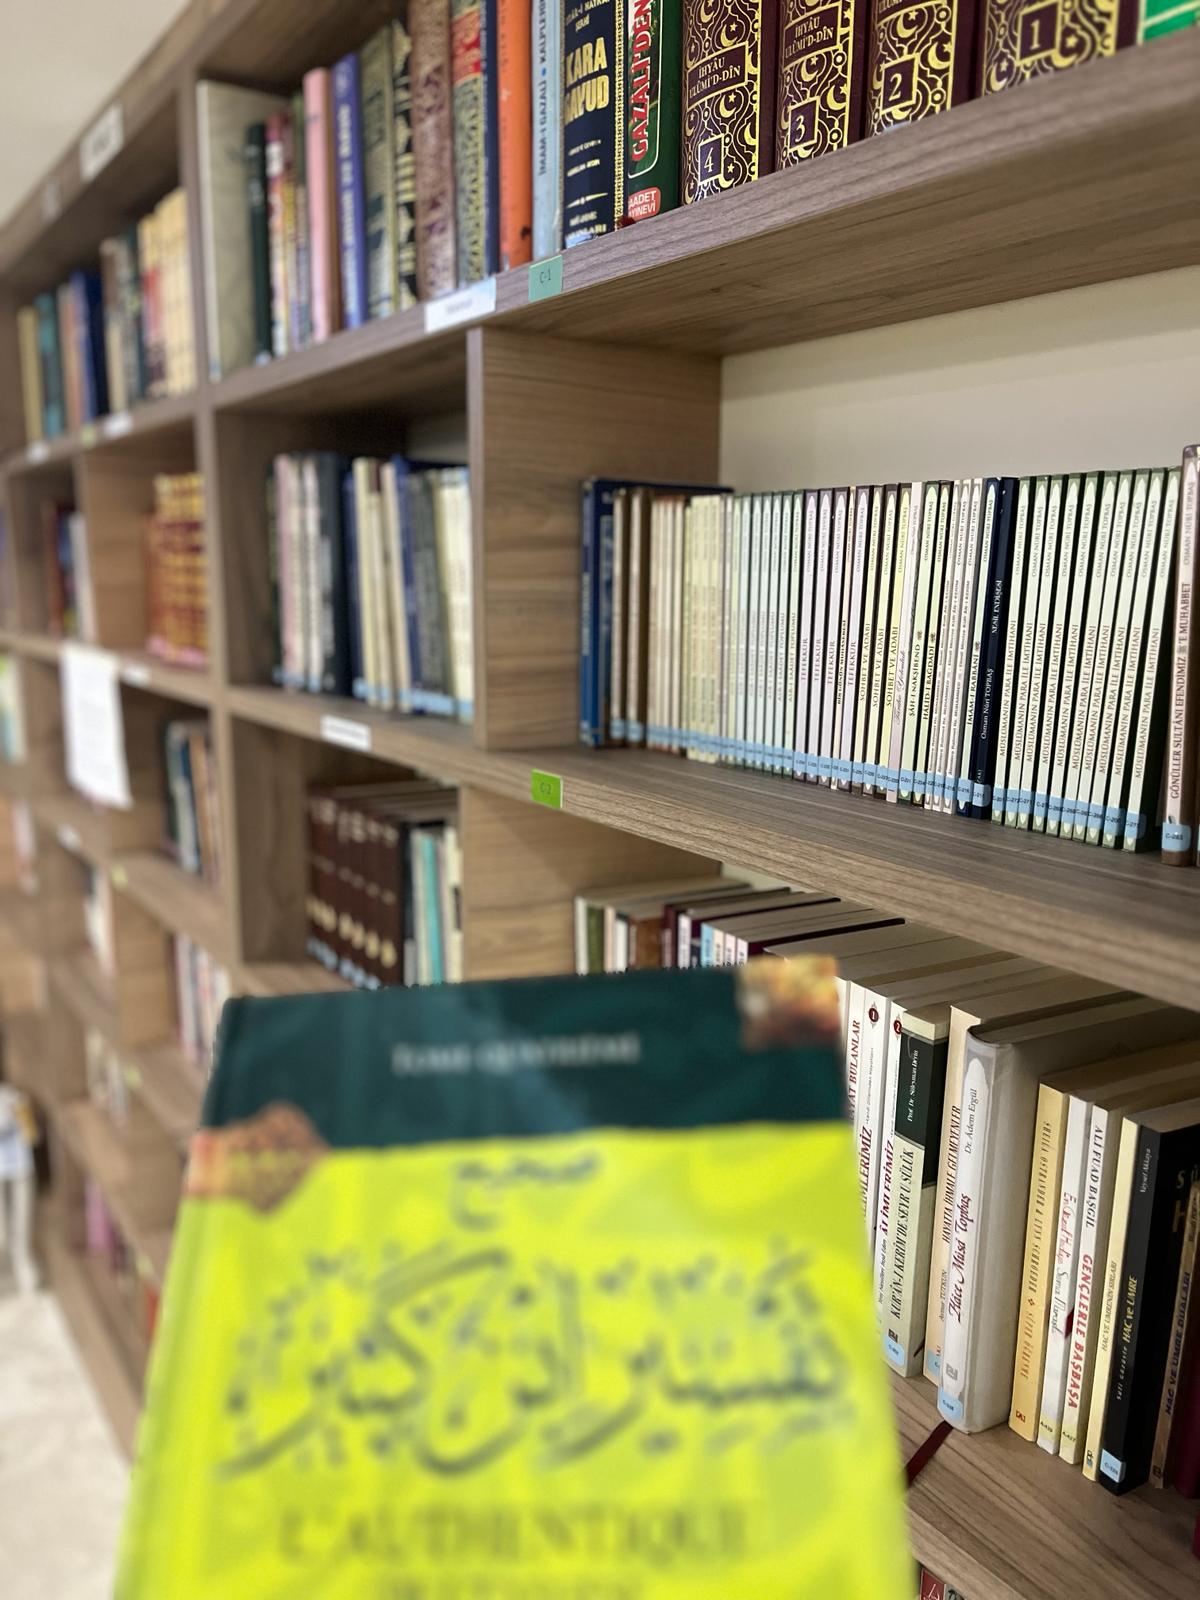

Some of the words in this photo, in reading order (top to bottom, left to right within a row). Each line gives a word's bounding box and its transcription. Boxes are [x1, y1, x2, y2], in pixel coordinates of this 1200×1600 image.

[1030, 19, 1040, 49] 1
[565, 37, 607, 88] KARA
[888, 73, 902, 101] 2
[793, 113, 806, 142] 3
[703, 148, 714, 173] 4
[1179, 581, 1192, 635] MUHABBET
[863, 653, 868, 663] VE
[875, 659, 882, 669] VE
[890, 657, 896, 668] VE
[860, 666, 868, 701] SOHBET
[872, 672, 881, 708] SOHBET
[886, 670, 895, 707] SOHBET
[1020, 681, 1028, 701] PARA
[1032, 682, 1040, 702] PARA
[1048, 684, 1056, 703] PARA
[1062, 685, 1072, 704] PARA
[1173, 656, 1188, 707] EFENDİMİZ
[981, 715, 989, 739] Osman
[985, 668, 994, 698] TOPBAŞ
[1079, 687, 1089, 707] PARA
[1092, 687, 1102, 708] PARA
[1107, 689, 1117, 710] PARA
[1123, 690, 1133, 711] PARA
[1142, 692, 1153, 713] PARA
[1169, 749, 1184, 800] GÖNÜLLER
[848, 1020, 860, 1085] BULANLAR
[967, 1088, 981, 1106] Ergül
[963, 1139, 974, 1154] Dr.
[1092, 1126, 1106, 1147] ALİ
[1090, 1149, 1103, 1183] FUAD
[898, 1194, 909, 1220] SEYR
[953, 1193, 975, 1234] Topbaş
[1085, 1185, 1099, 1229] BAŞGİL
[941, 1206, 953, 1244] HAYATTA
[1075, 1253, 1093, 1338] GENÇLERLE
[1125, 1274, 1138, 1306] UMRE
[1125, 1307, 1135, 1319] ve
[1100, 1334, 1110, 1352] HAC
[1121, 1319, 1133, 1343] HAC
[1172, 1330, 1184, 1366] UMRE
[1066, 1341, 1085, 1409] BAŞBAŞA
[1169, 1369, 1179, 1385] VE
[1164, 1388, 1174, 1415] HAC
